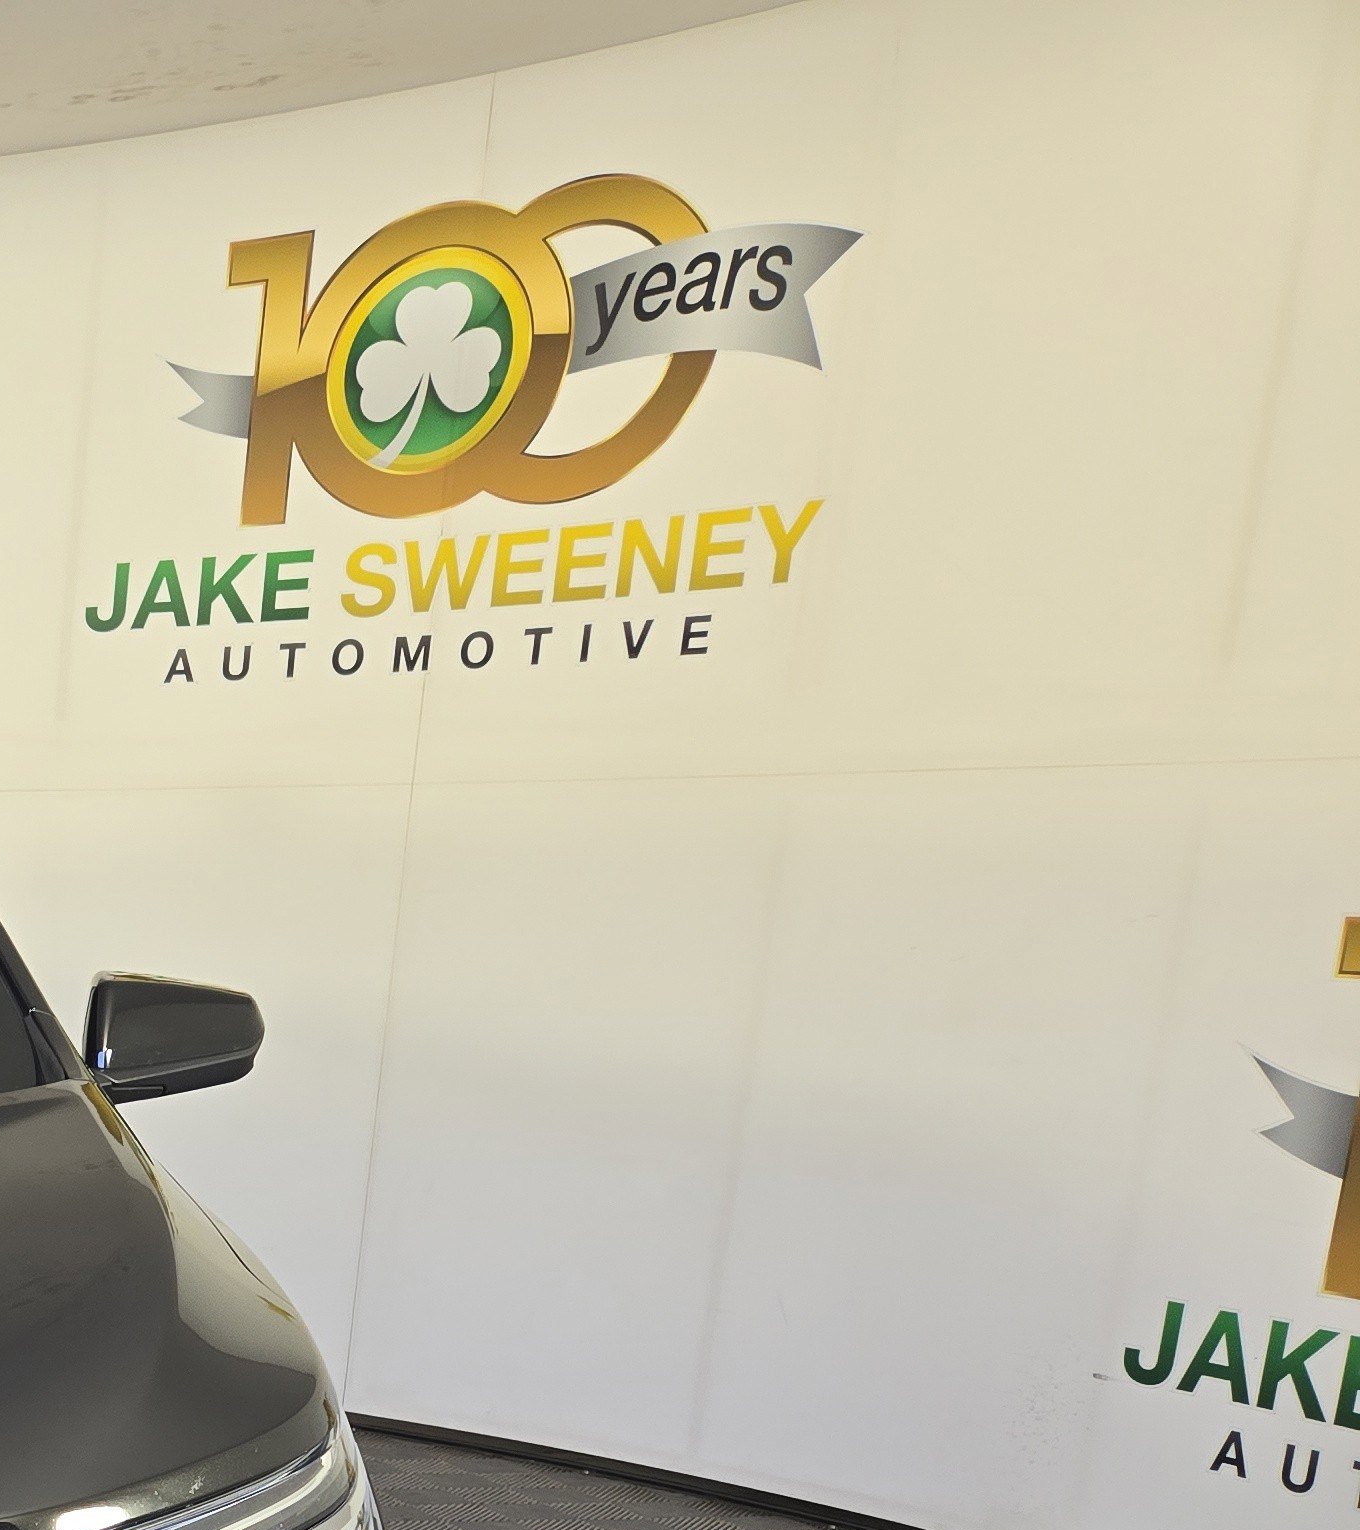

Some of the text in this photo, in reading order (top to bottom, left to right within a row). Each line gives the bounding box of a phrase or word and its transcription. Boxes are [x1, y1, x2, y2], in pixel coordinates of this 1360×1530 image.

[228, 173, 717, 526] 100
[586, 244, 793, 357] years
[85, 499, 825, 632] JAKE SWEENEY
[164, 614, 713, 683] AUTOMOTIVE
